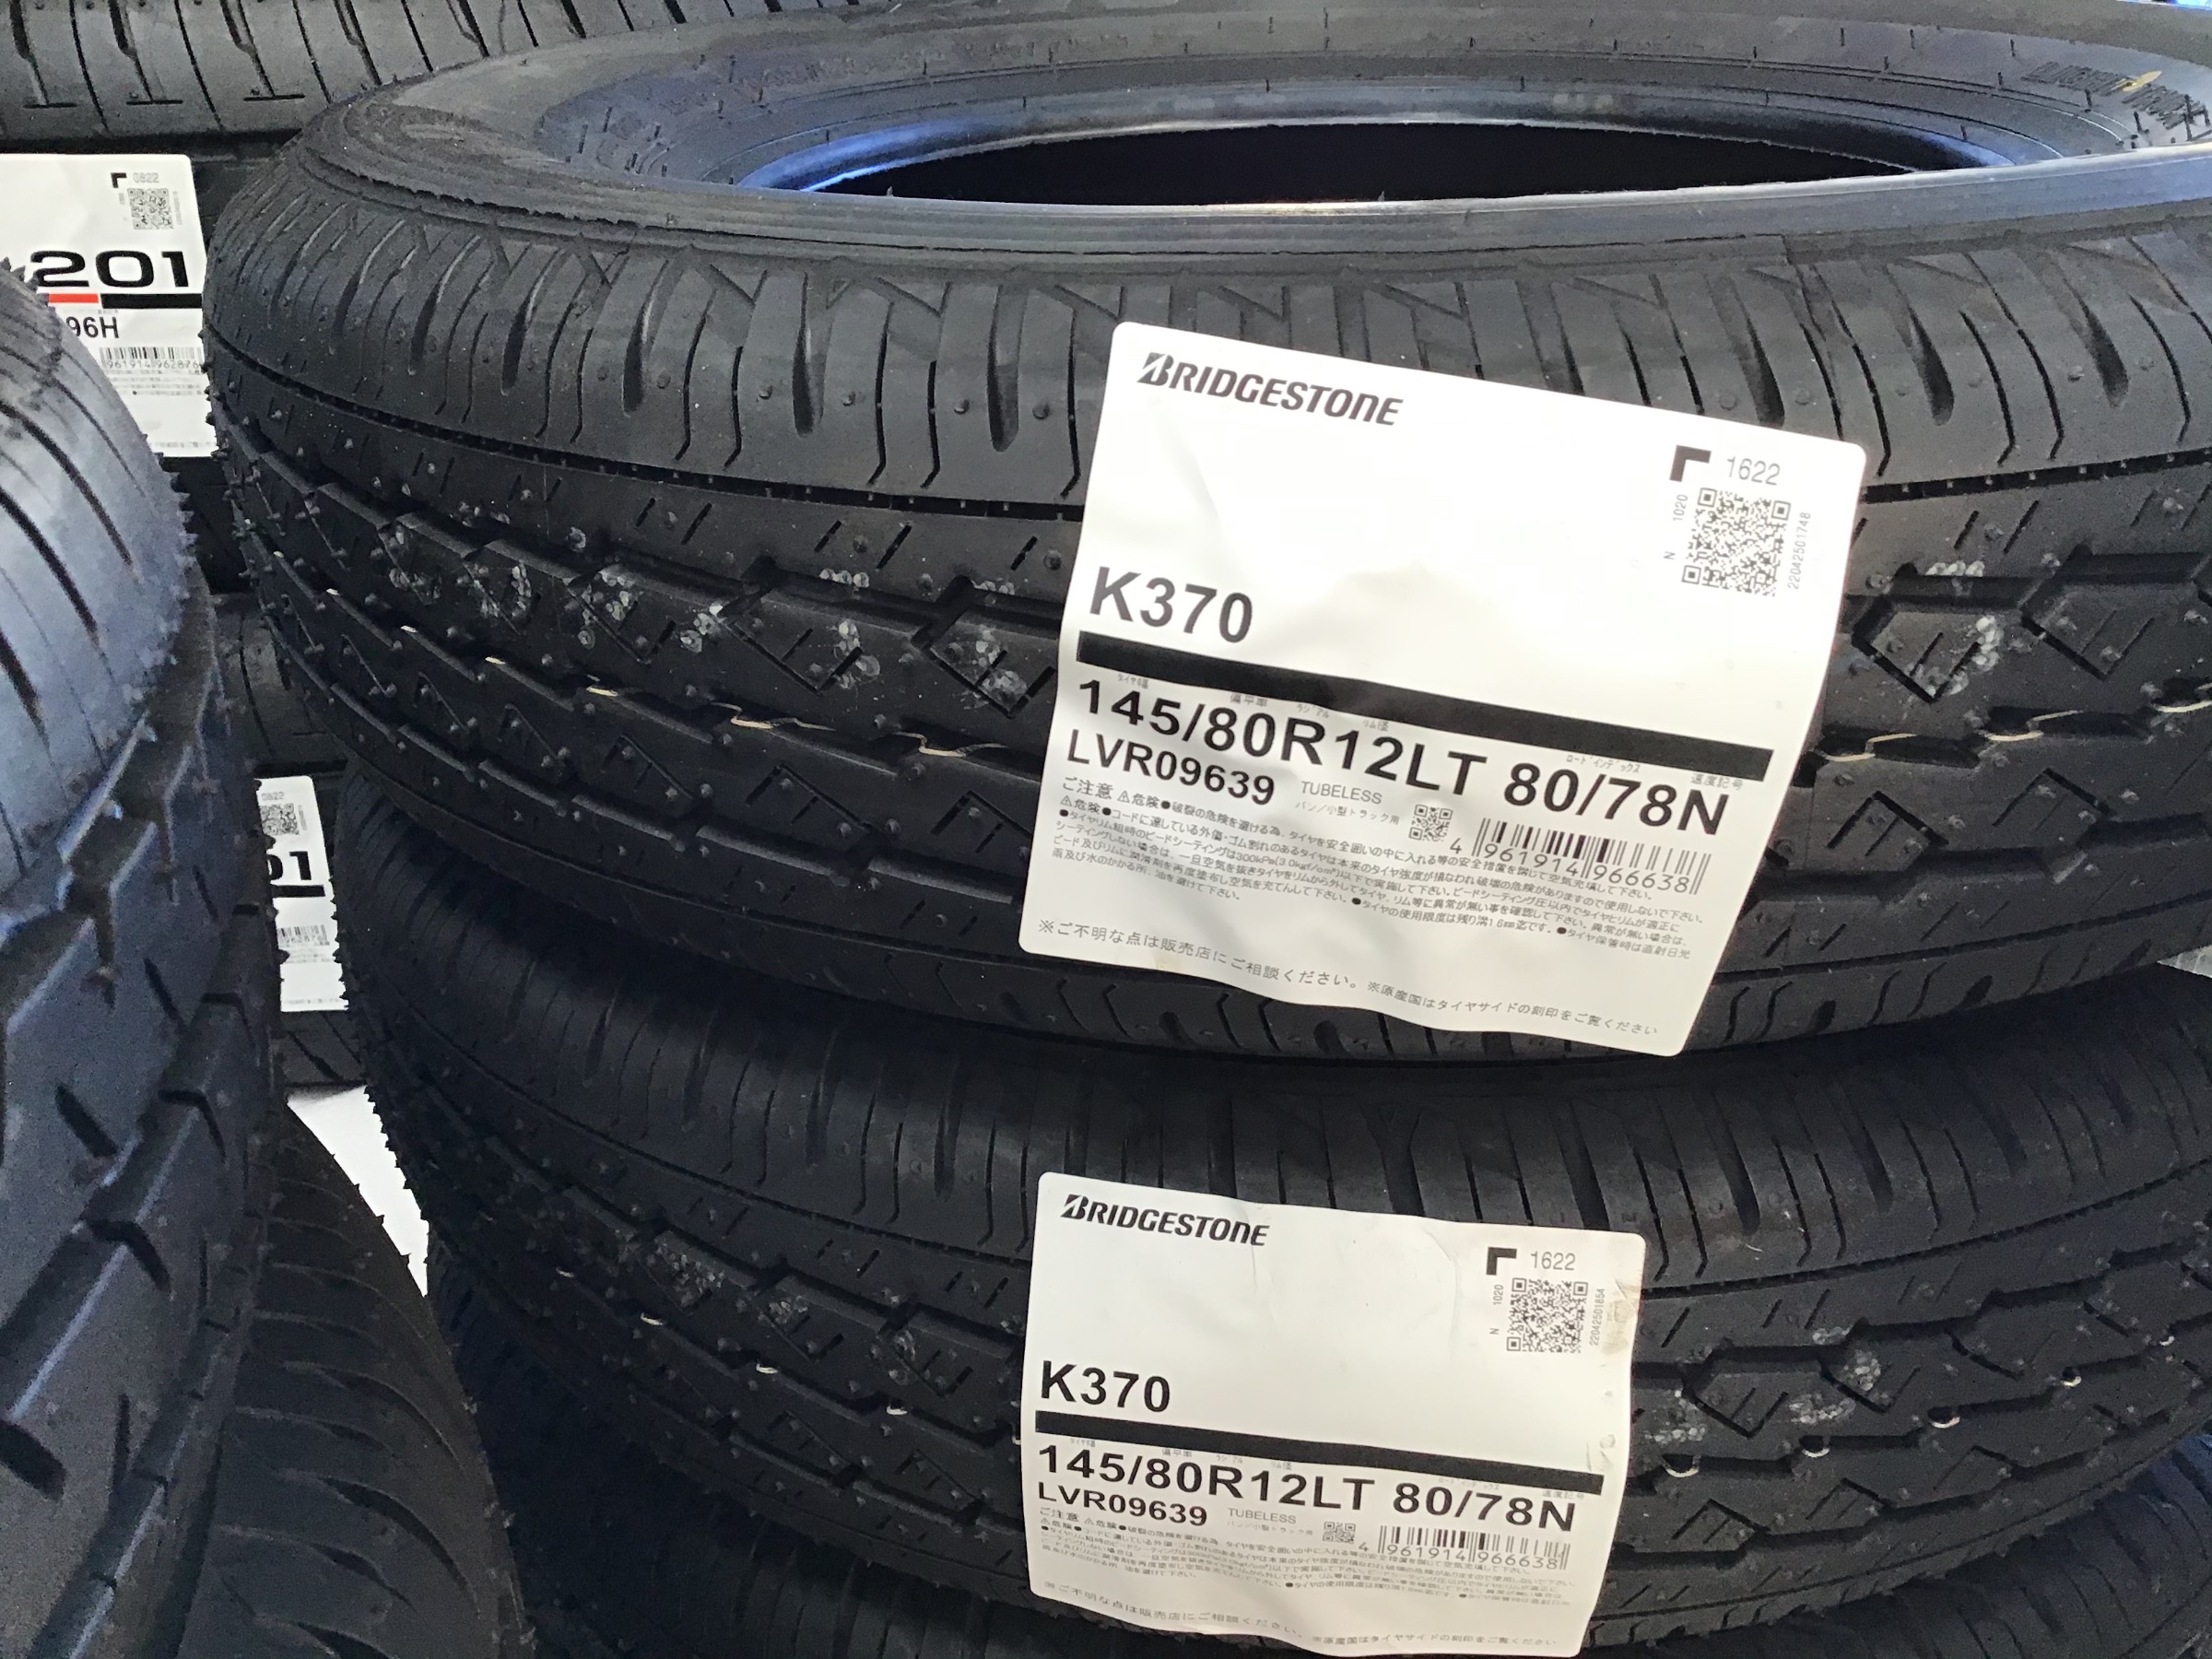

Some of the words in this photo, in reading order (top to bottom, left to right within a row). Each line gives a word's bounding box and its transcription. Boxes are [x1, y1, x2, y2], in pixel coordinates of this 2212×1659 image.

[30, 250, 190, 288] 201
[1136, 351, 1405, 427] BRIDGESTONE
[1726, 456, 1781, 486] 1622
[1663, 550, 1676, 560] N
[1673, 494, 1688, 522] 1020
[1787, 512, 1811, 590] 22042501748
[1089, 565, 1253, 643] K370
[1066, 728, 1277, 806] LVR09639
[1079, 678, 1488, 796] 145/80R12LT
[1503, 762, 1730, 835] 80/78N
[1300, 780, 1383, 805] TUBELESS
[1060, 1194, 1271, 1246] BRIDGESTONE
[1530, 1250, 1576, 1271] 1622
[1493, 1284, 1504, 1305] 1020
[1041, 1359, 1171, 1413] K370
[1038, 1481, 1208, 1527] LVR09639
[1039, 1444, 1375, 1511] 145/80R12LT
[1393, 1482, 1576, 1532] 80/78N
[1227, 1507, 1297, 1524] TUBELESS
